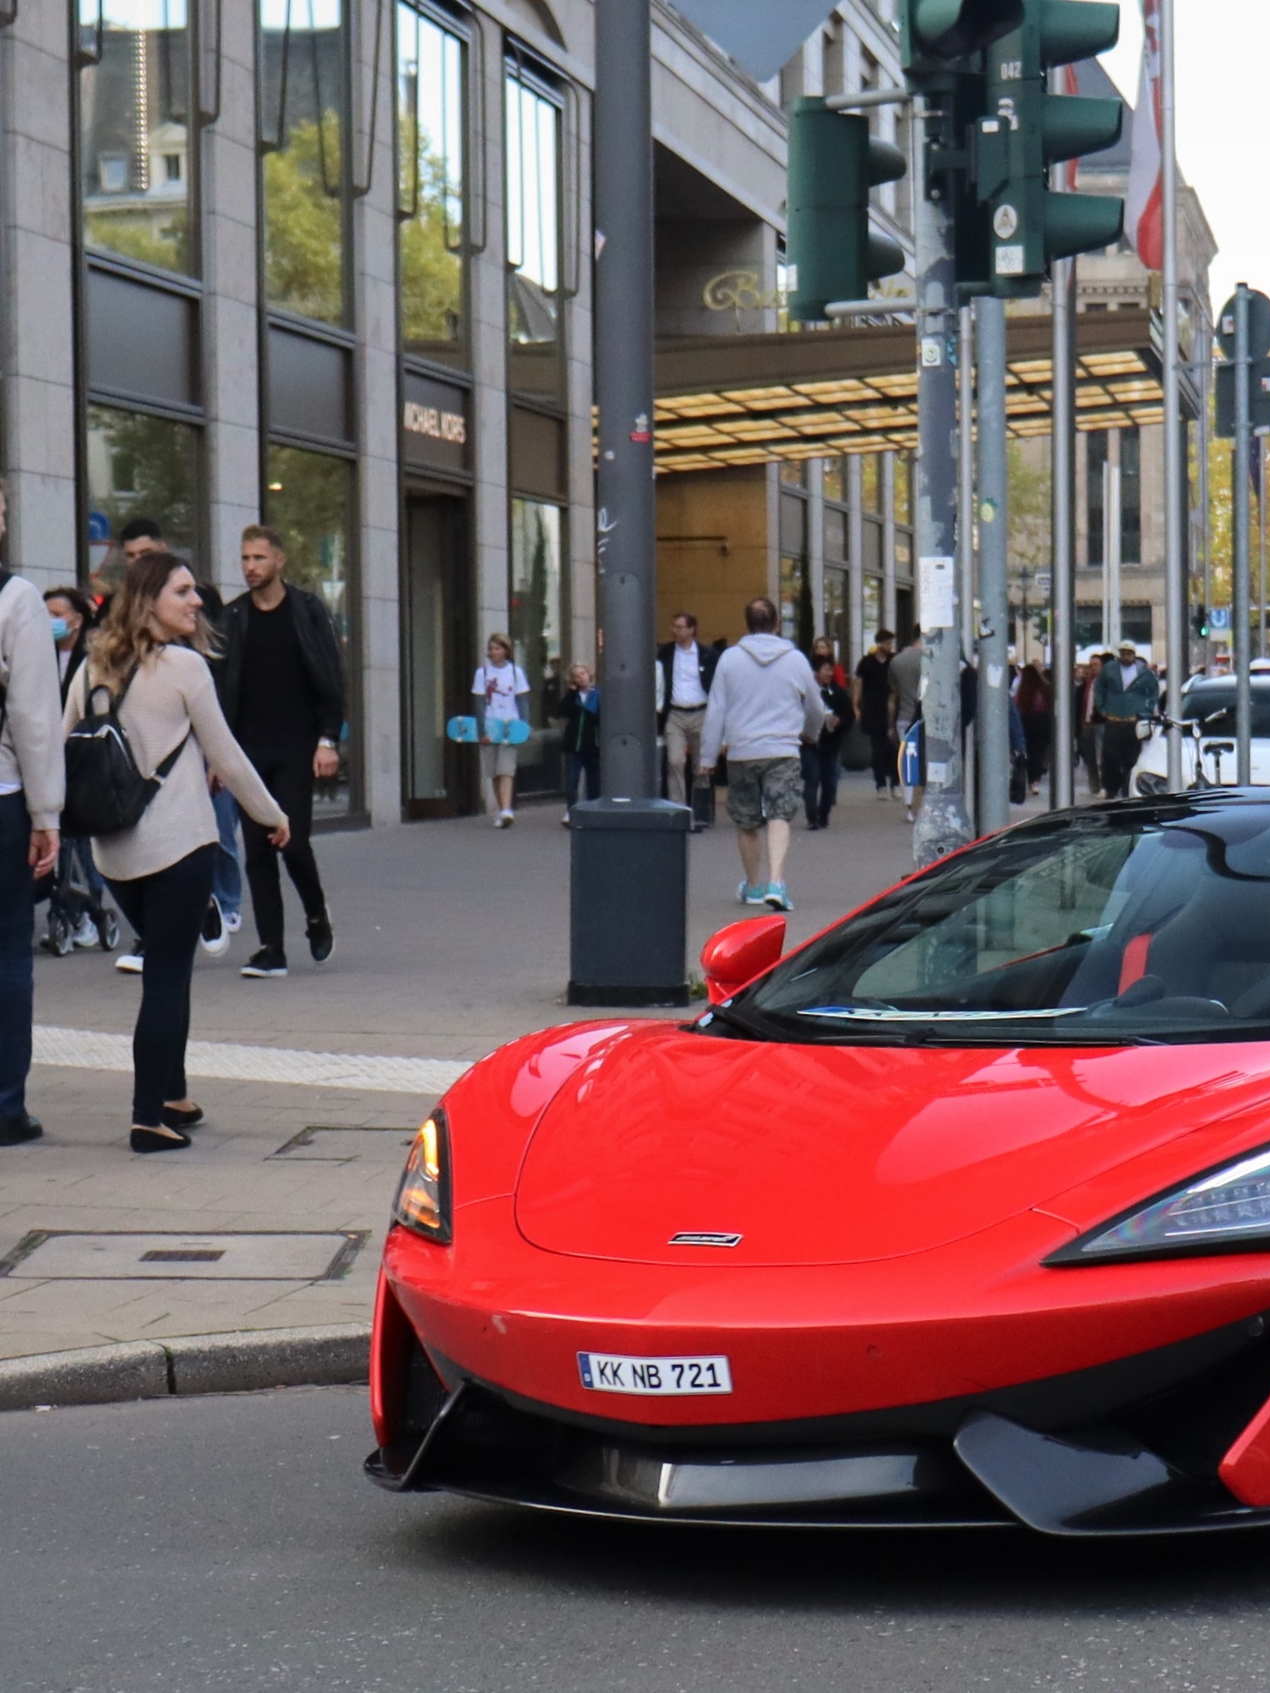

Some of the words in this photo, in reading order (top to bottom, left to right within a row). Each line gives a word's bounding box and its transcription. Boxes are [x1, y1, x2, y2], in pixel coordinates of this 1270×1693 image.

[1001, 61, 1022, 80] 042
[597, 1360, 625, 1388] KK
[632, 1363, 662, 1389] NB
[671, 1362, 721, 1388] 721
